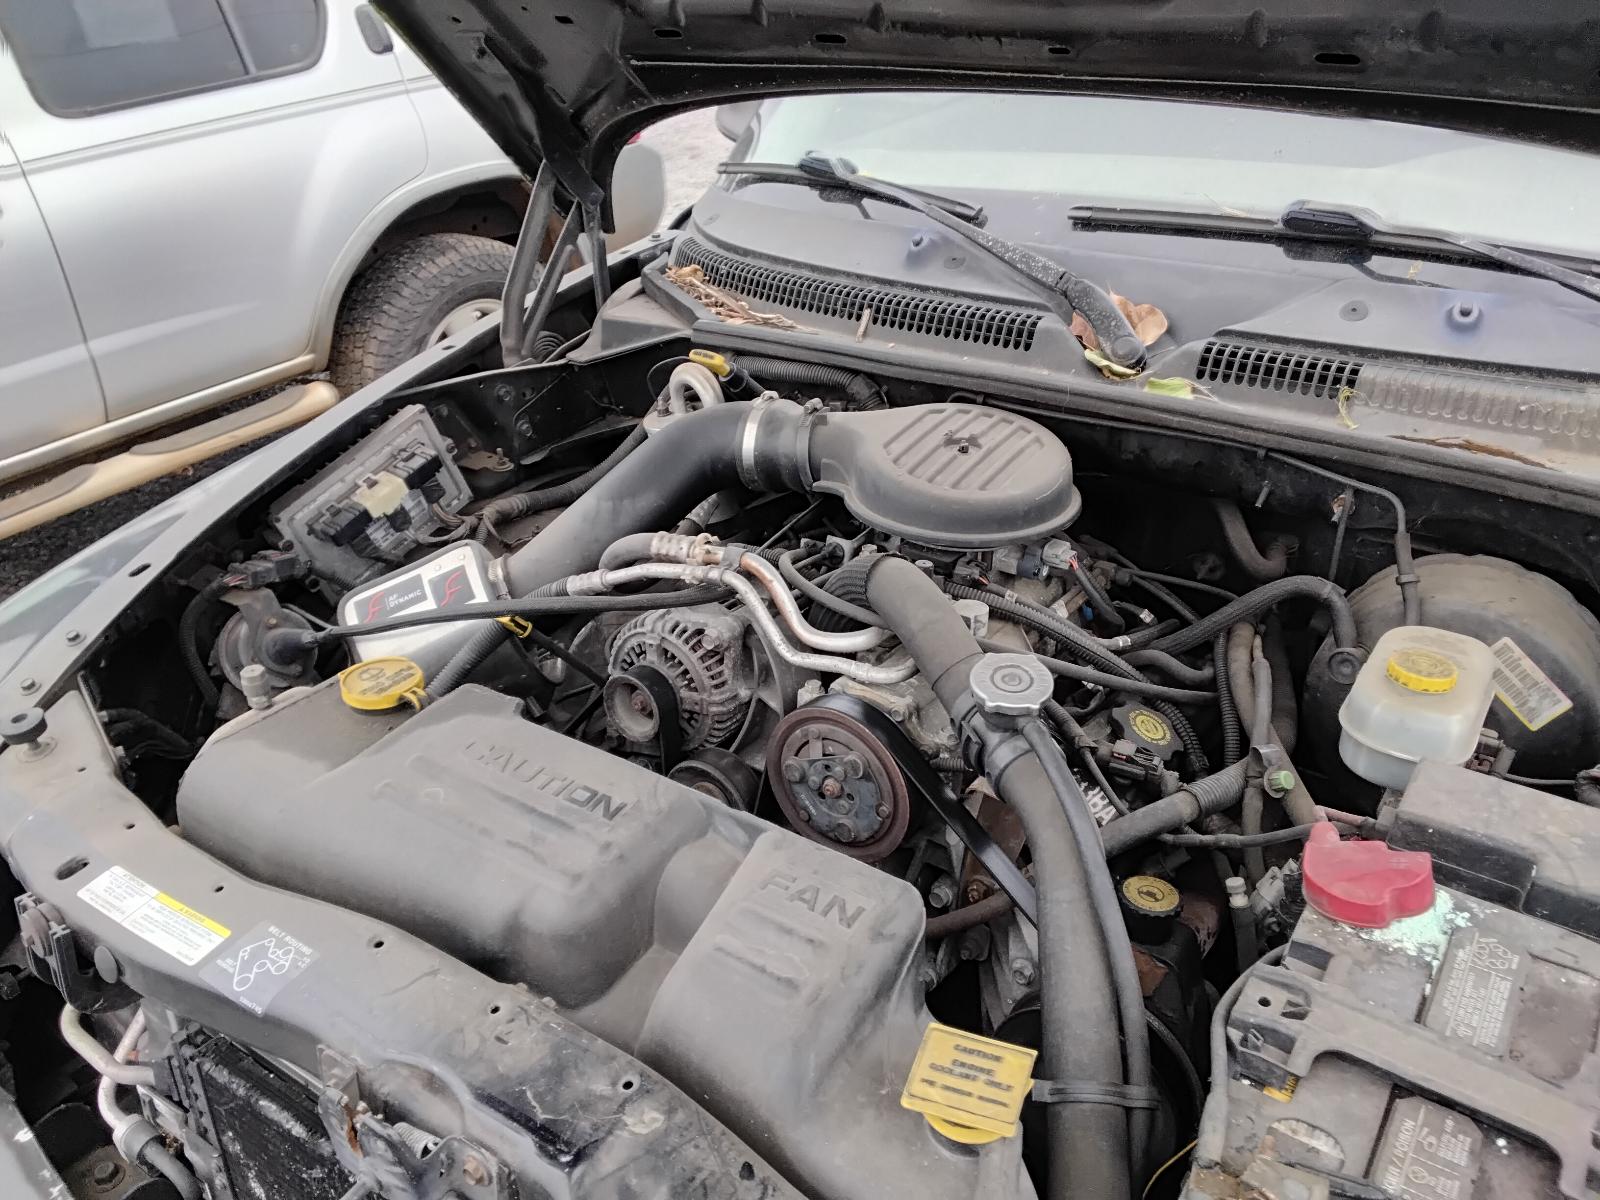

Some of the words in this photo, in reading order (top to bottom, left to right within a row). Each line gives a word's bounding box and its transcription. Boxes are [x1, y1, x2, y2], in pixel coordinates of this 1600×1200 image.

[389, 589, 422, 608] DYNAMIC
[465, 740, 628, 822] CAUTION
[759, 870, 867, 930] FAN
[953, 1043, 1004, 1062] CAUTION
